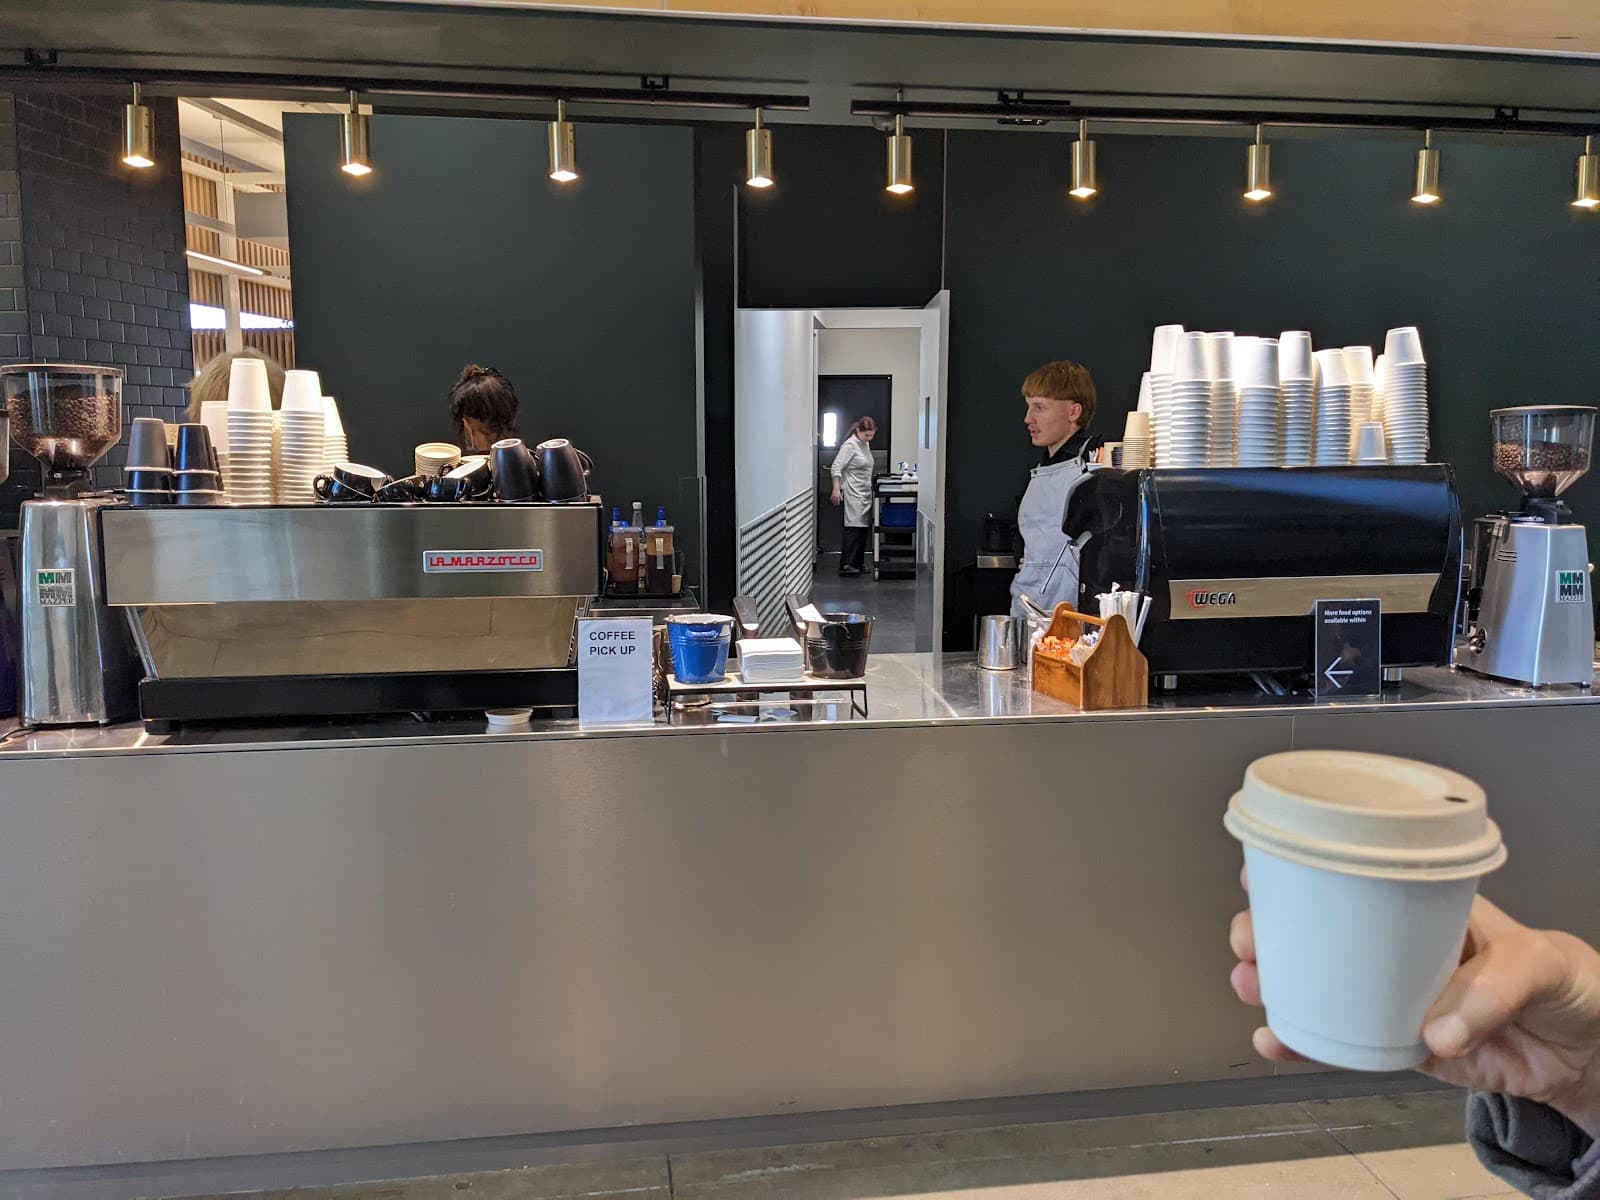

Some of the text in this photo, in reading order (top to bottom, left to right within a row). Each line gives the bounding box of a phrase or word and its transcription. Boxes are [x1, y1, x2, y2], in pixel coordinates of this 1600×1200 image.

[429, 556, 537, 567] LA MARZOCCO
[1194, 592, 1236, 605] WEGA
[1352, 609, 1372, 617] options
[589, 631, 636, 641] COFFEE
[589, 645, 636, 655] PICK UP
